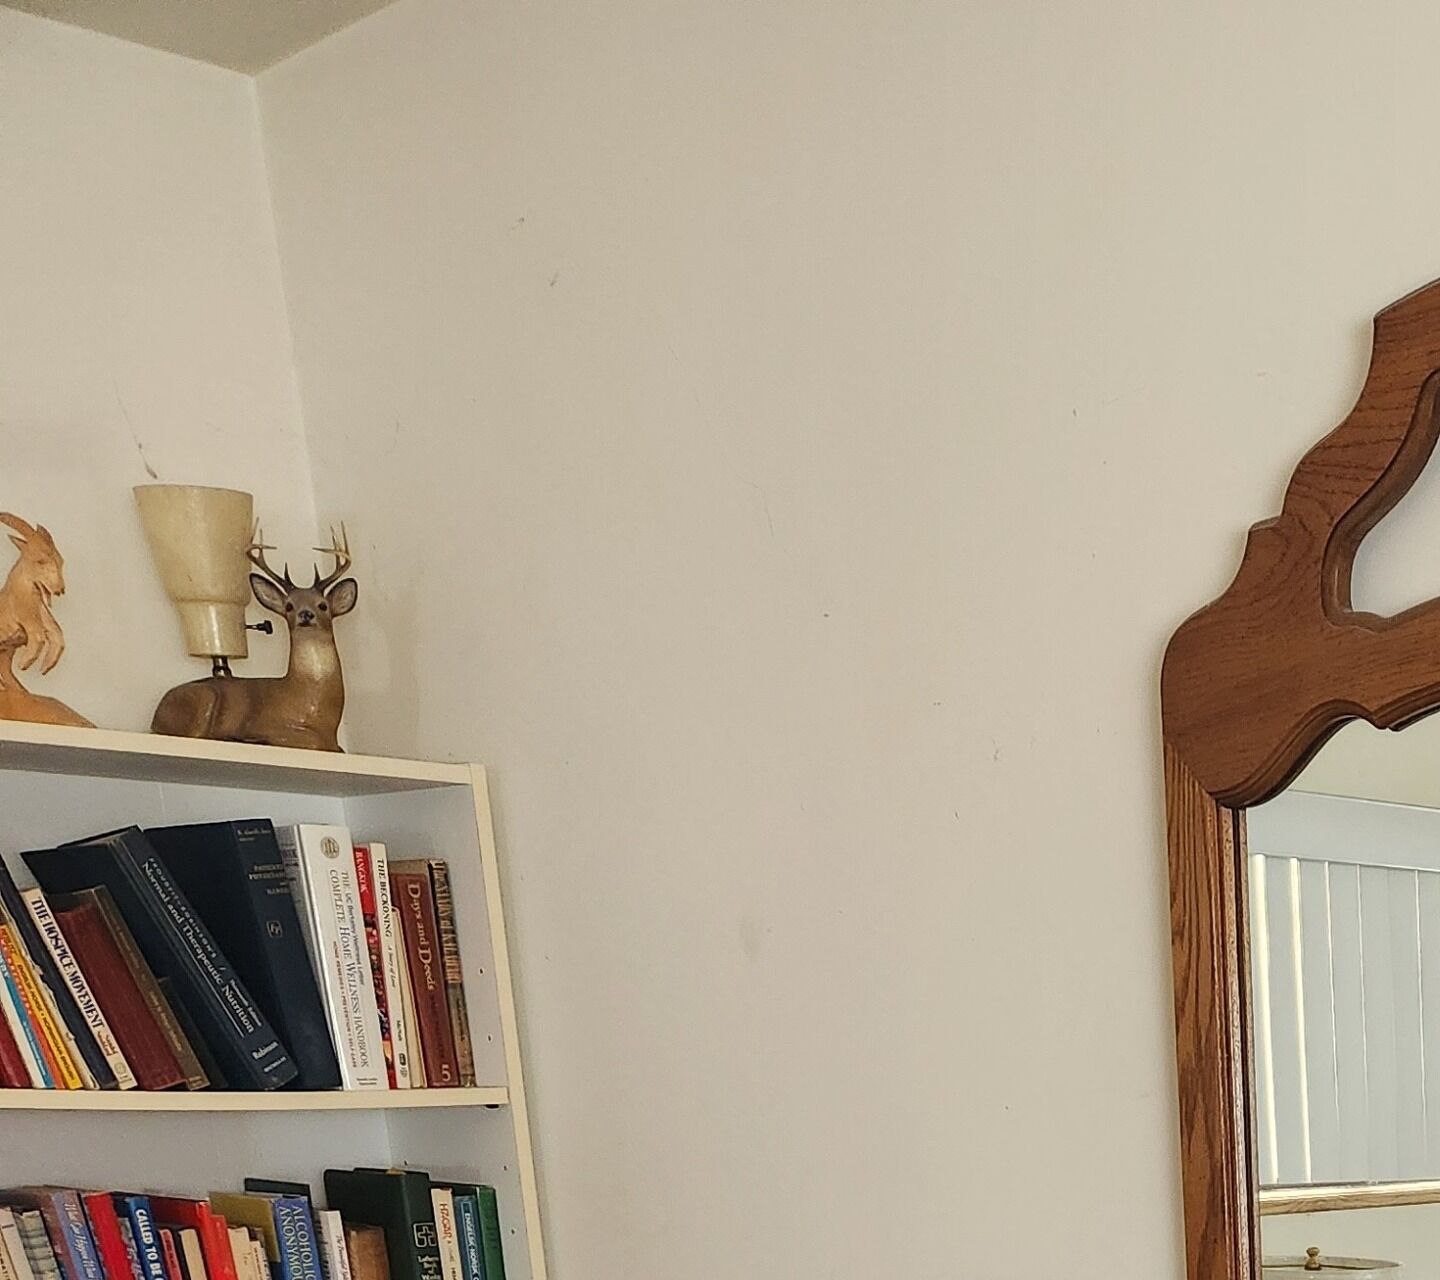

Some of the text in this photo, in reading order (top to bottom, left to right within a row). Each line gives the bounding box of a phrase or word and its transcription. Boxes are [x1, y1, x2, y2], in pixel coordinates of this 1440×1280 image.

[330, 869, 344, 922] COMPLETE
[376, 858, 391, 937] THE BECKONING
[141, 858, 256, 1033] Normal and Therapeutic Nutrition
[340, 925, 353, 958] HOME
[406, 881, 438, 991] Days and Deeds
[30, 896, 103, 1031] THE HOSPICE MOVEMENT
[345, 961, 362, 1014] WELLNESS
[353, 1014, 368, 1067] HANDBOOK
[441, 1064, 451, 1082] 5
[135, 1207, 153, 1245] CALLED
[146, 1245, 157, 1260] TO
[150, 1261, 161, 1277] BE
